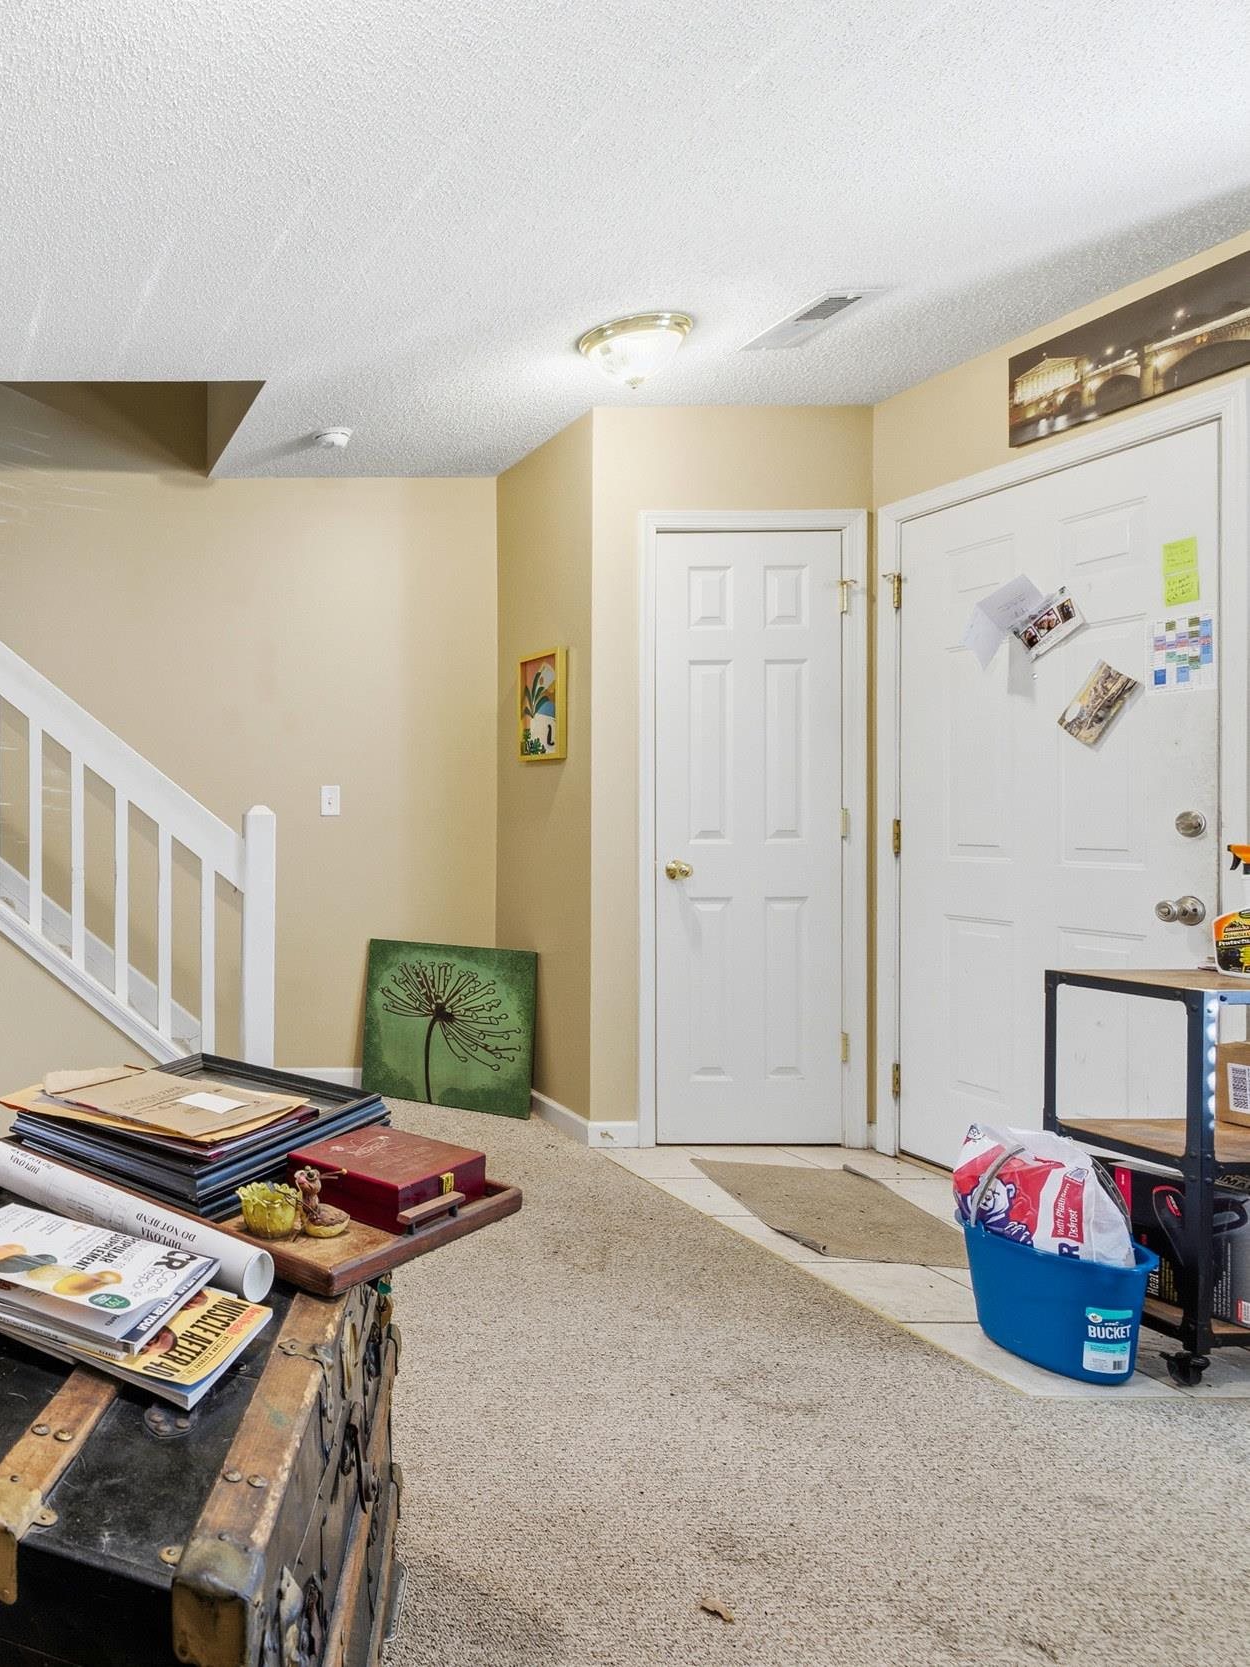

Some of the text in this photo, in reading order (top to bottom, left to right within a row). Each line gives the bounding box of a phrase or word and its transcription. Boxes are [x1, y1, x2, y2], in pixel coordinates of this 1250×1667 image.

[136, 1212, 197, 1242] DO NOT BEND
[1068, 1209, 1079, 1238] Defrost
[141, 1226, 182, 1250] DIPLOMA
[99, 1238, 141, 1264] POPULAR
[154, 1250, 198, 1270] CR
[1147, 1271, 1159, 1296] Heat
[189, 1297, 251, 1338] MUSCLE
[1087, 1324, 1132, 1339] BUCKET
[158, 1330, 213, 1367] AFTER
[142, 1361, 180, 1378] 40
